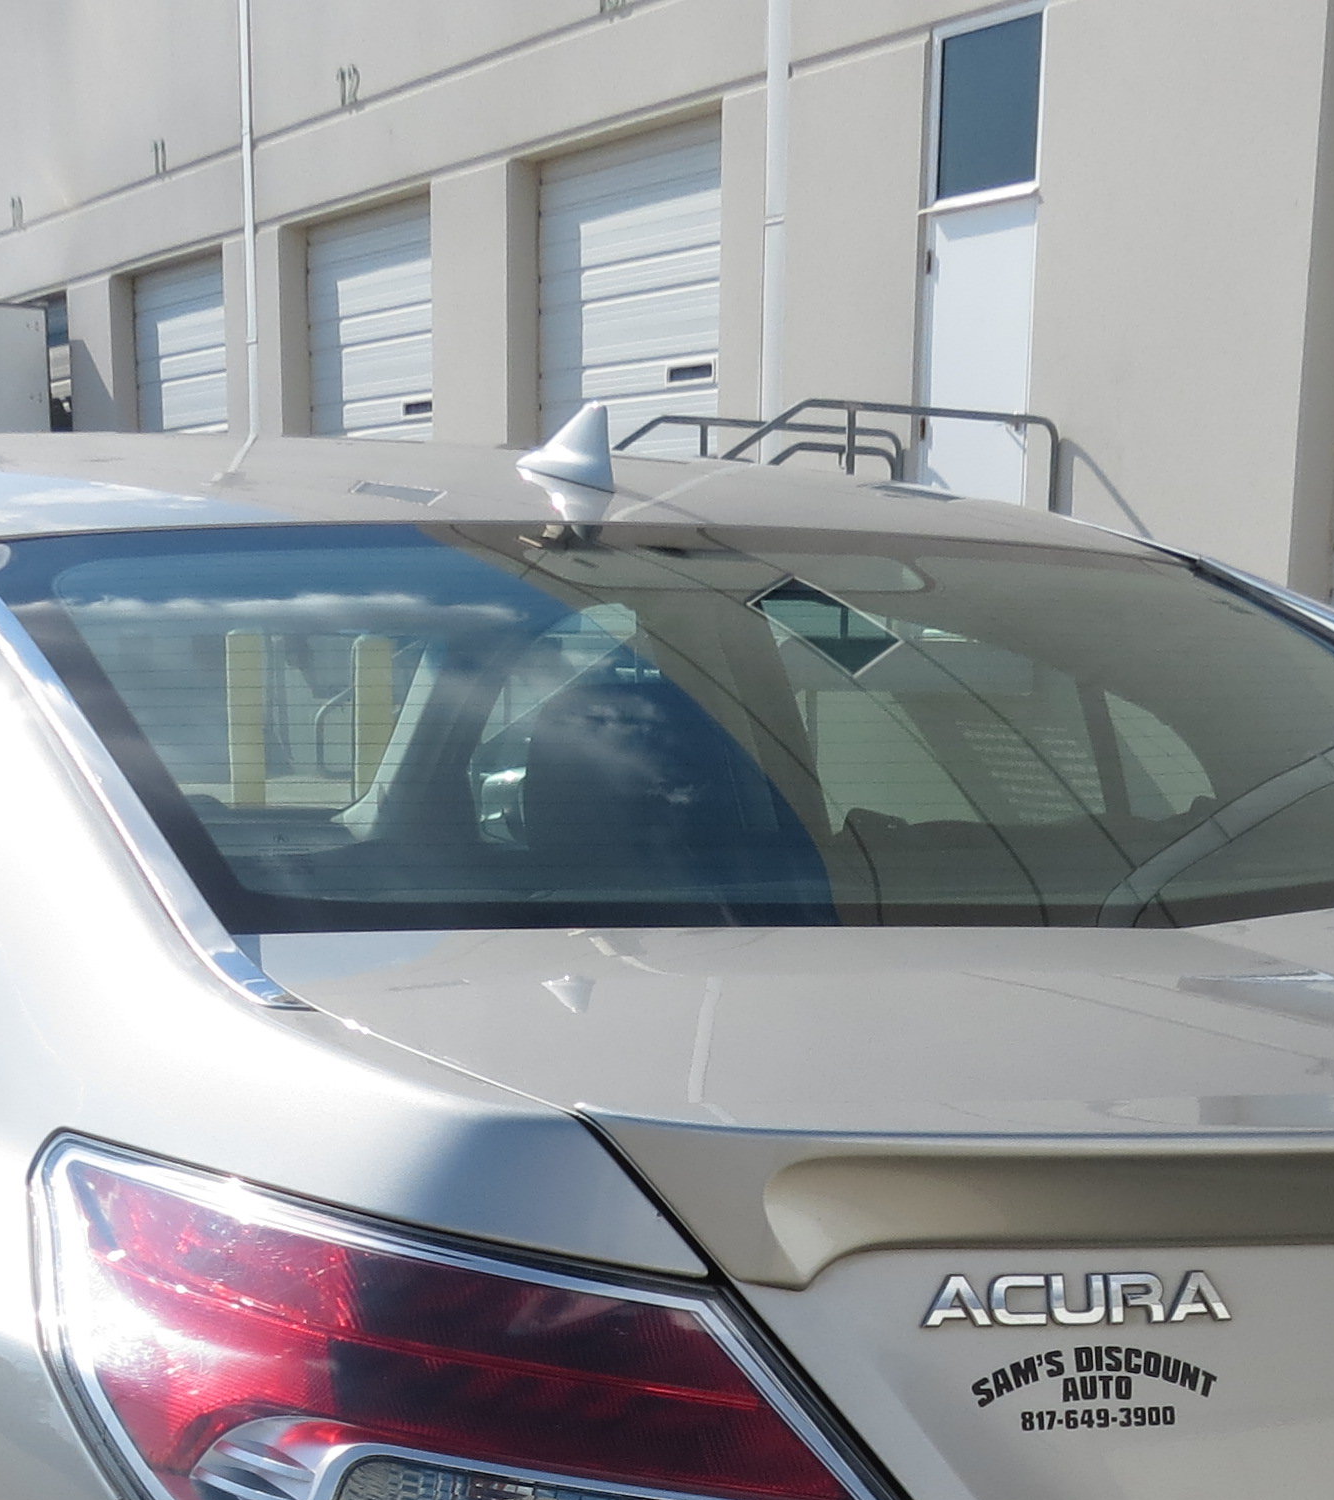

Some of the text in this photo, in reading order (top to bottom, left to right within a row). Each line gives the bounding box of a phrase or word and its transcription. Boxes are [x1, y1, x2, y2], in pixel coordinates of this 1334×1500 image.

[920, 1270, 1232, 1327] ACURA
[971, 1346, 1218, 1408] SAM'S DISCOUNT
[1062, 1375, 1133, 1402] AUTO
[1021, 1406, 1176, 1431] 817-649-3900
